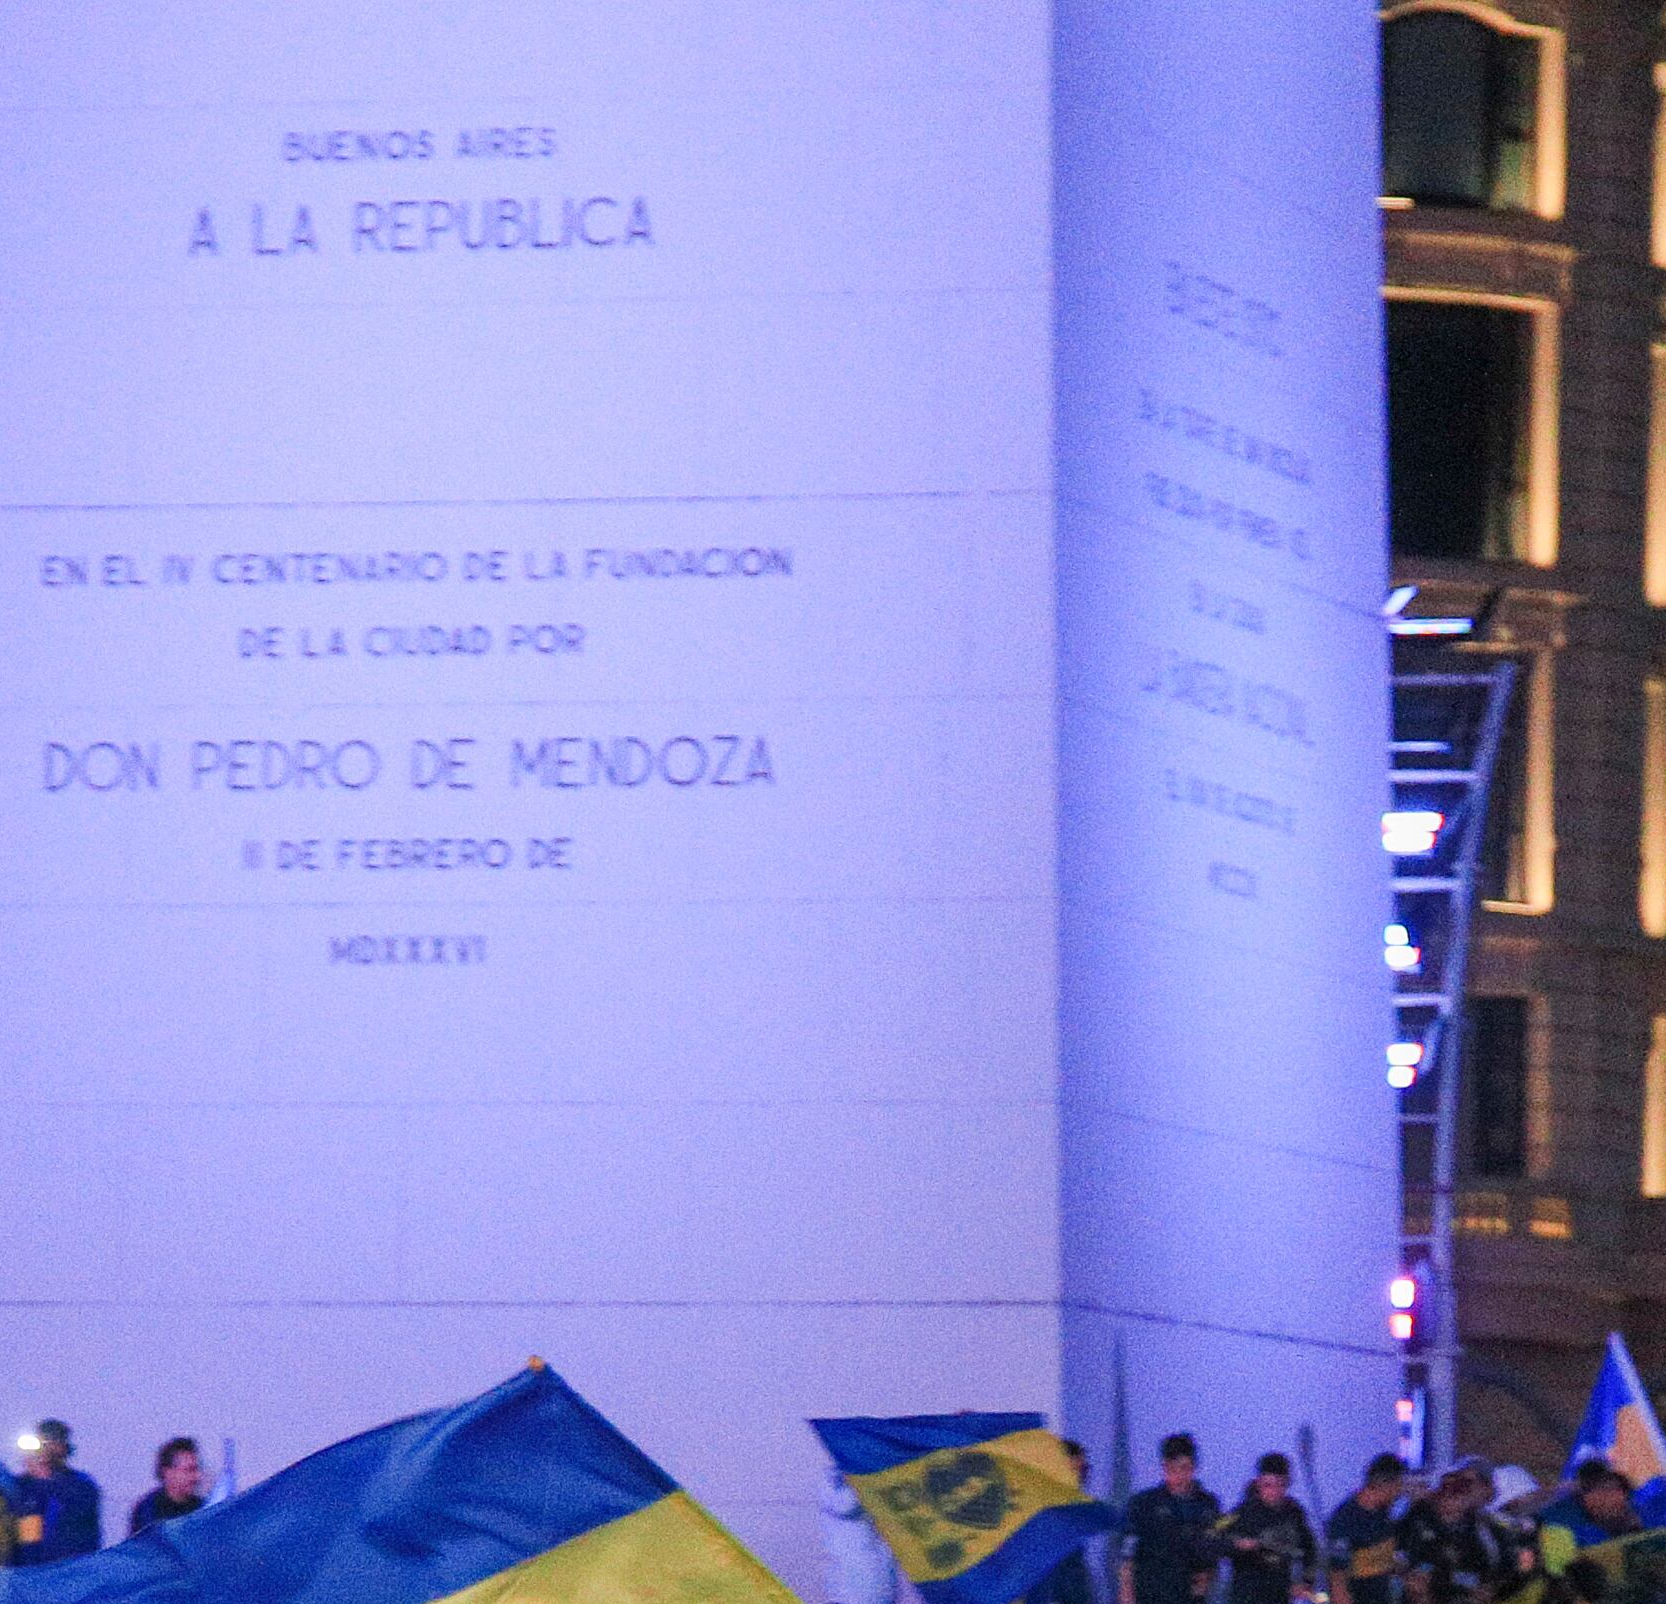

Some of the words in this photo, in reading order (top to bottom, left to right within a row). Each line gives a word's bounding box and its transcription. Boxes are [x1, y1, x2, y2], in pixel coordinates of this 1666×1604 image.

[281, 128, 435, 165] BUENOS
[455, 125, 558, 160] AIRES
[186, 205, 221, 258] A
[250, 202, 319, 258] LA
[351, 195, 657, 255] REPUBLICA
[39, 554, 89, 590] EN
[100, 553, 148, 589] EL
[209, 550, 449, 587] CENTENARIO
[462, 548, 509, 584] DE
[524, 550, 569, 582] LA
[583, 545, 794, 581] FUNDACION
[237, 625, 284, 661] DE
[299, 628, 349, 661] LA
[506, 622, 587, 657] POR
[42, 740, 161, 795] DON
[191, 737, 382, 794] PEDRO
[410, 736, 478, 792] DE
[510, 733, 777, 791] MENDOZA
[275, 838, 322, 873] DE
[335, 836, 514, 873] FEBRERO
[525, 835, 574, 872] DE
